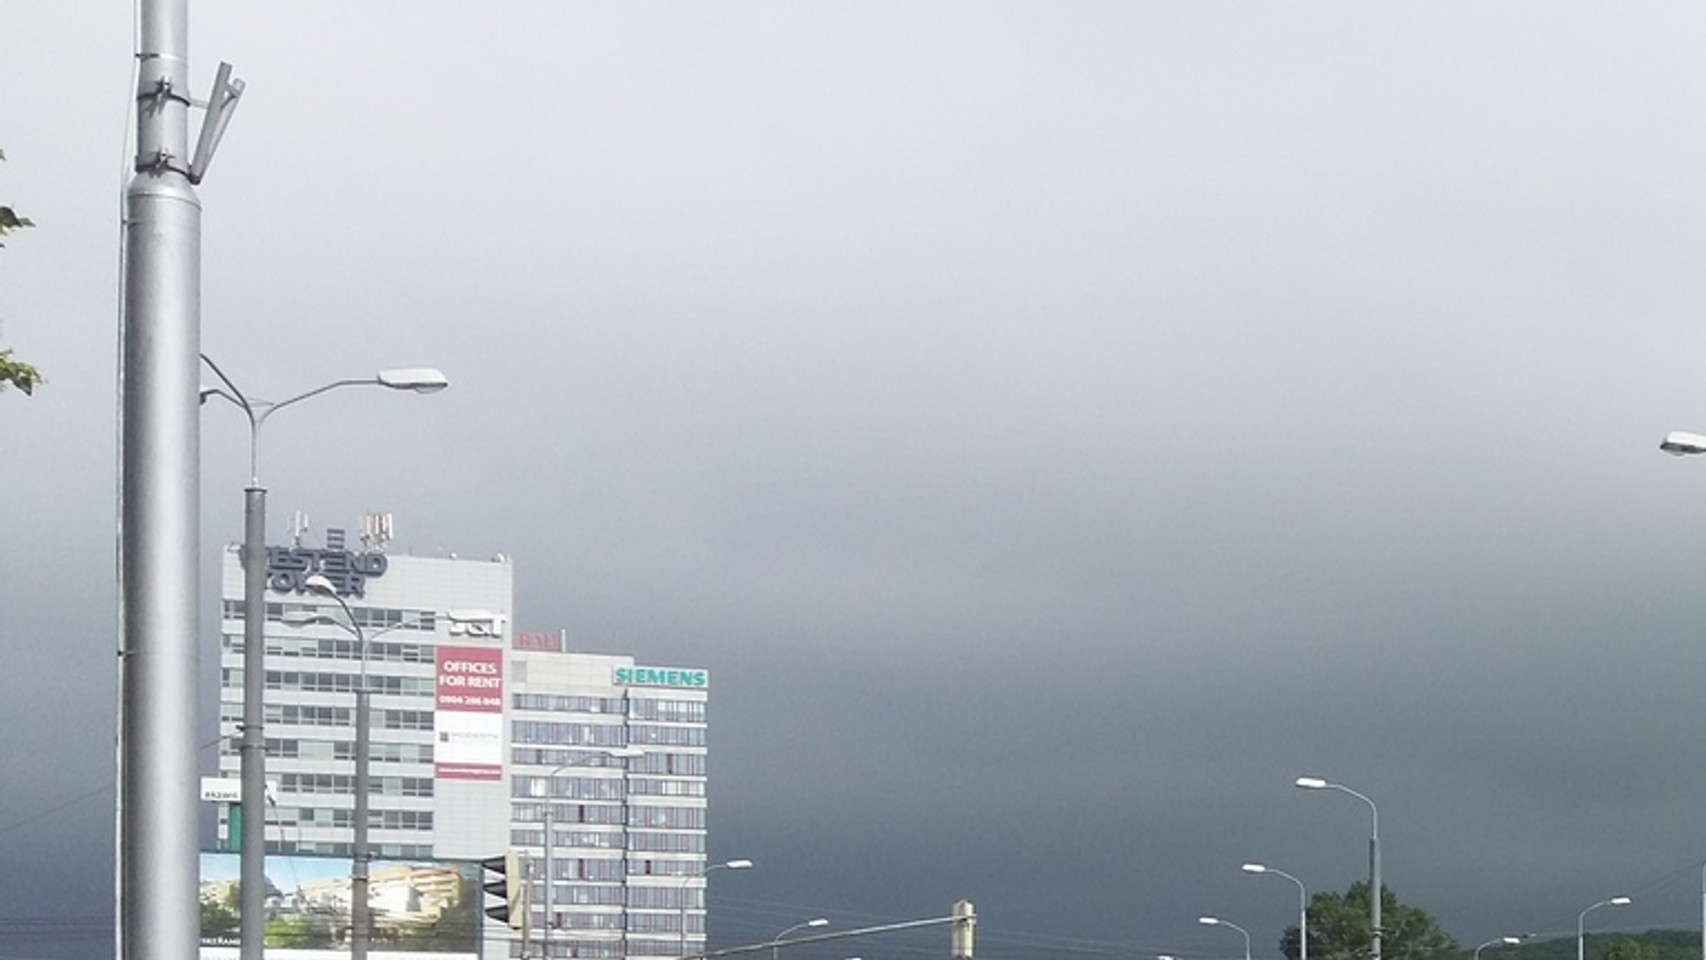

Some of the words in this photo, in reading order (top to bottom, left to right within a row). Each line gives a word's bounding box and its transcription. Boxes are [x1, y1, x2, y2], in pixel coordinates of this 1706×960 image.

[240, 547, 388, 578] ESTEND
[443, 660, 497, 674] OFFICES
[439, 675, 466, 687] FOR
[467, 676, 502, 688] RENT
[615, 667, 706, 686] SIEMENS
